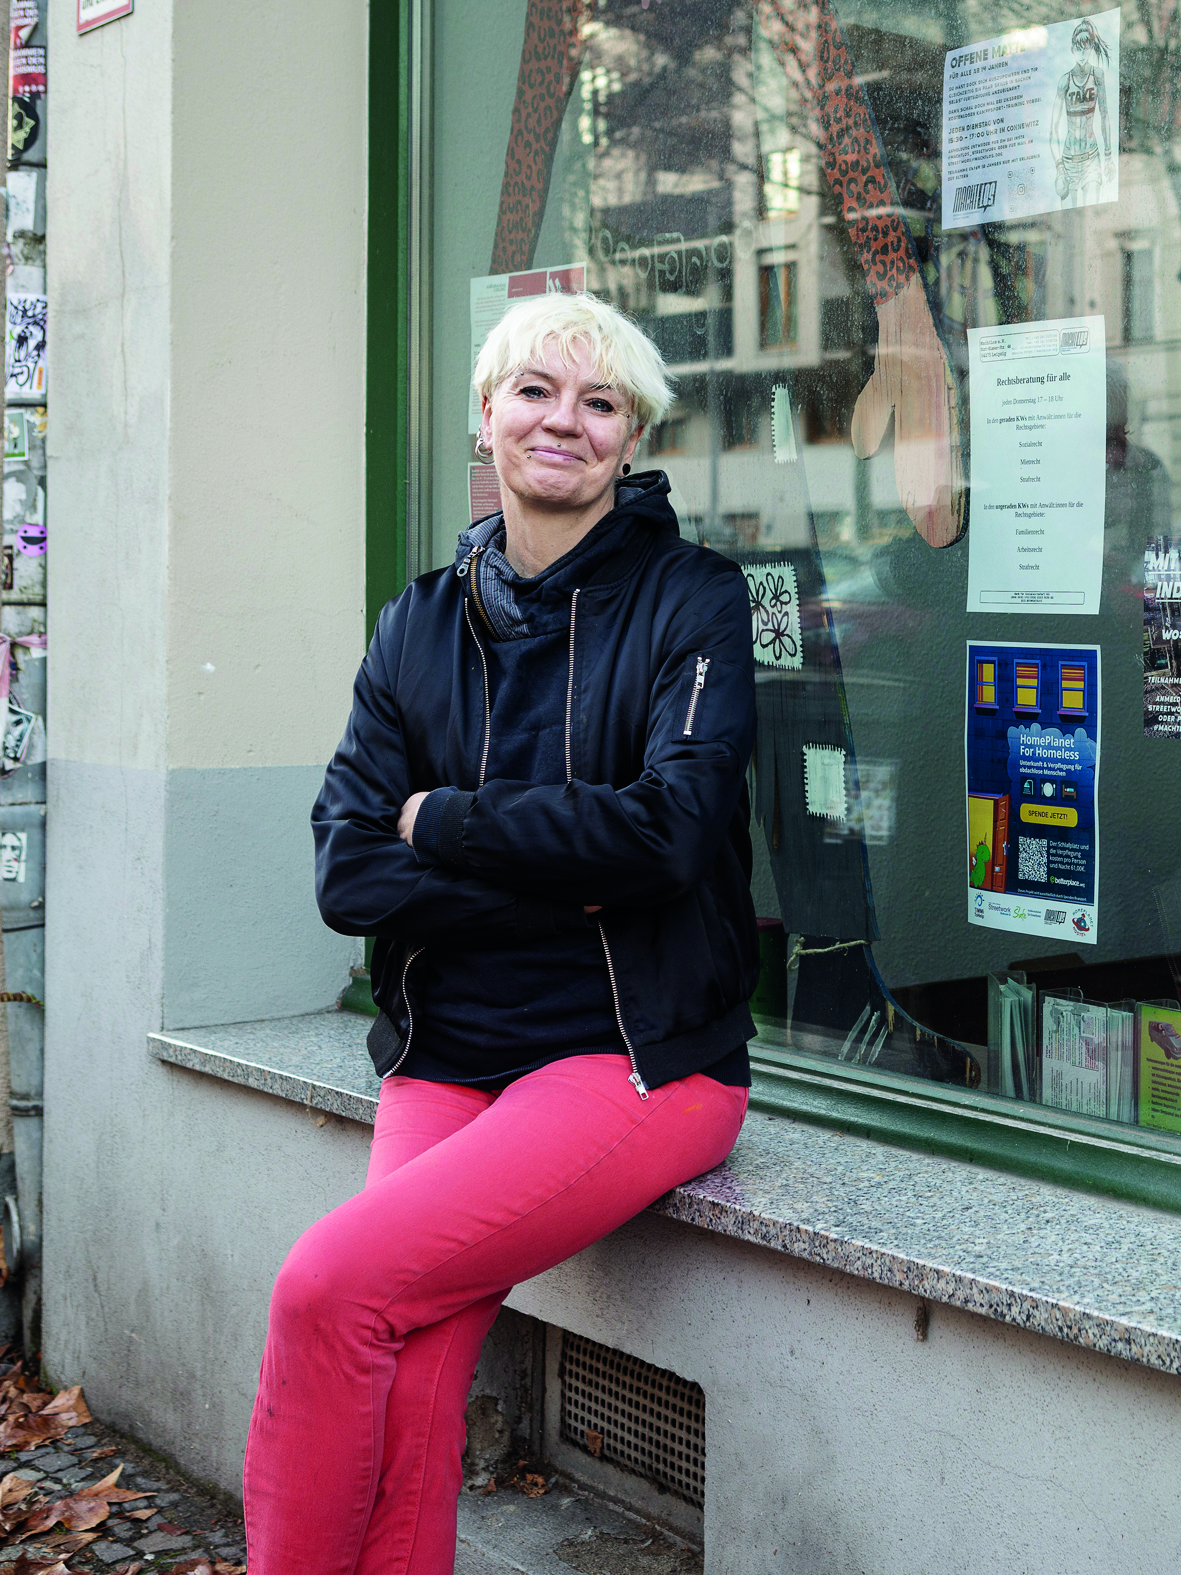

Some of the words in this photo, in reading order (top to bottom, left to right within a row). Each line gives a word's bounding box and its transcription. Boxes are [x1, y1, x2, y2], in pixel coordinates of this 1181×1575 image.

[951, 50, 988, 69] OFFENE
[1069, 87, 1095, 106] TAKE
[996, 376, 1045, 386] Rechtsberatung
[1046, 373, 1057, 382] für
[1058, 372, 1071, 381] alle
[1151, 553, 1180, 569] MIT
[1162, 630, 1181, 640] WO:
[1020, 734, 1075, 747] HomePlanet
[1020, 746, 1034, 756] For
[1036, 747, 1079, 760] Homeless
[1047, 762, 1075, 771] Verpflegung
[1028, 810, 1049, 818] SPENDE
[1049, 812, 1068, 820] JETZT!
[1057, 841, 1080, 849] Schlafplatz
[1057, 849, 1081, 858] Verpflegung
[988, 904, 1011, 912] Streetwork
